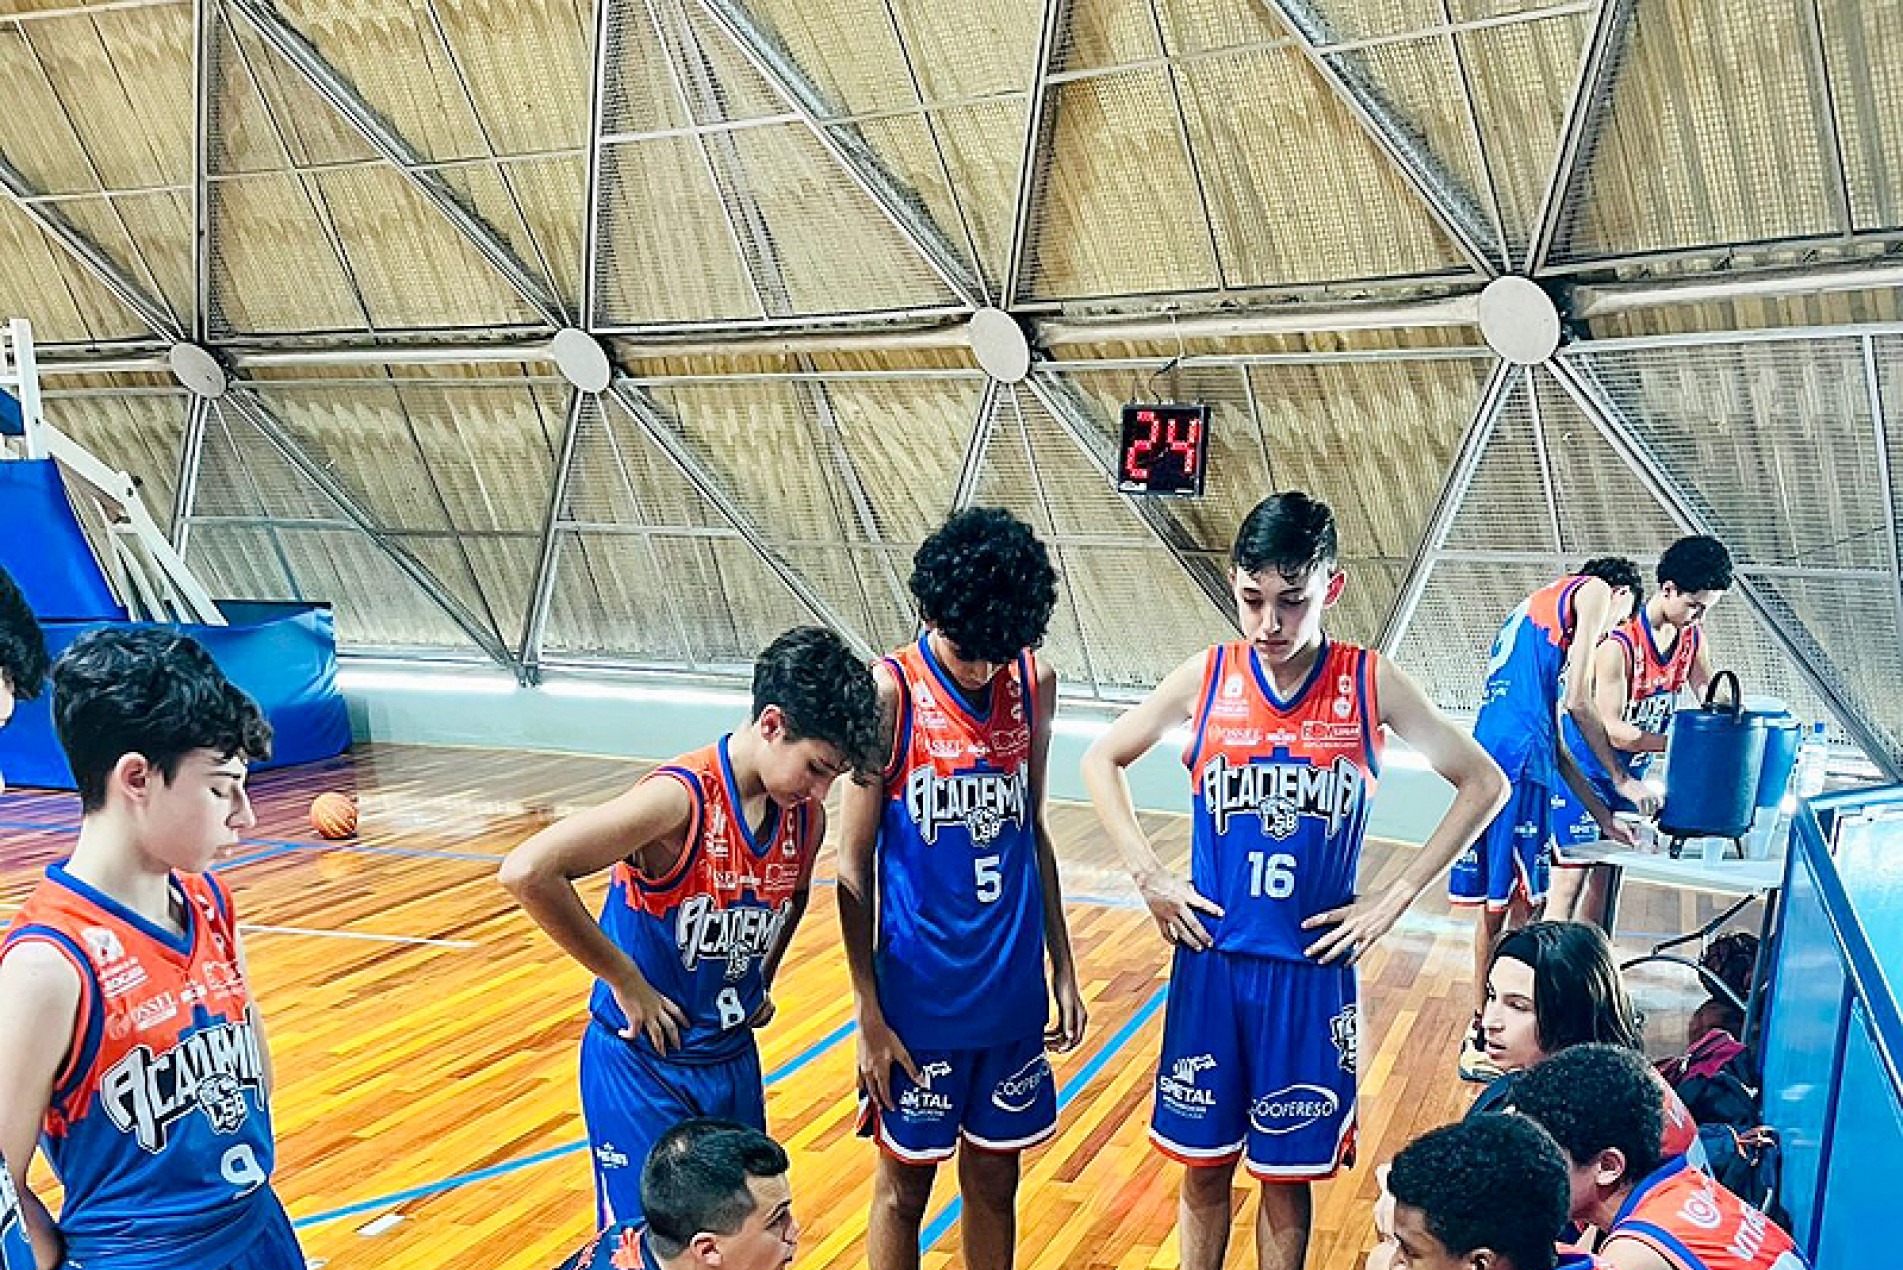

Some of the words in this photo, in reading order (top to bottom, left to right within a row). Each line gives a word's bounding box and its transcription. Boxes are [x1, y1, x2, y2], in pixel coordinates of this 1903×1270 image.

[1126, 411, 1198, 478] 24
[1203, 753, 1363, 836] ACADEMIA
[1265, 815, 1295, 832] LSB
[975, 854, 1001, 902] 5
[1249, 851, 1297, 898] 16
[717, 987, 746, 1030] 8
[221, 1144, 266, 1200] 9
